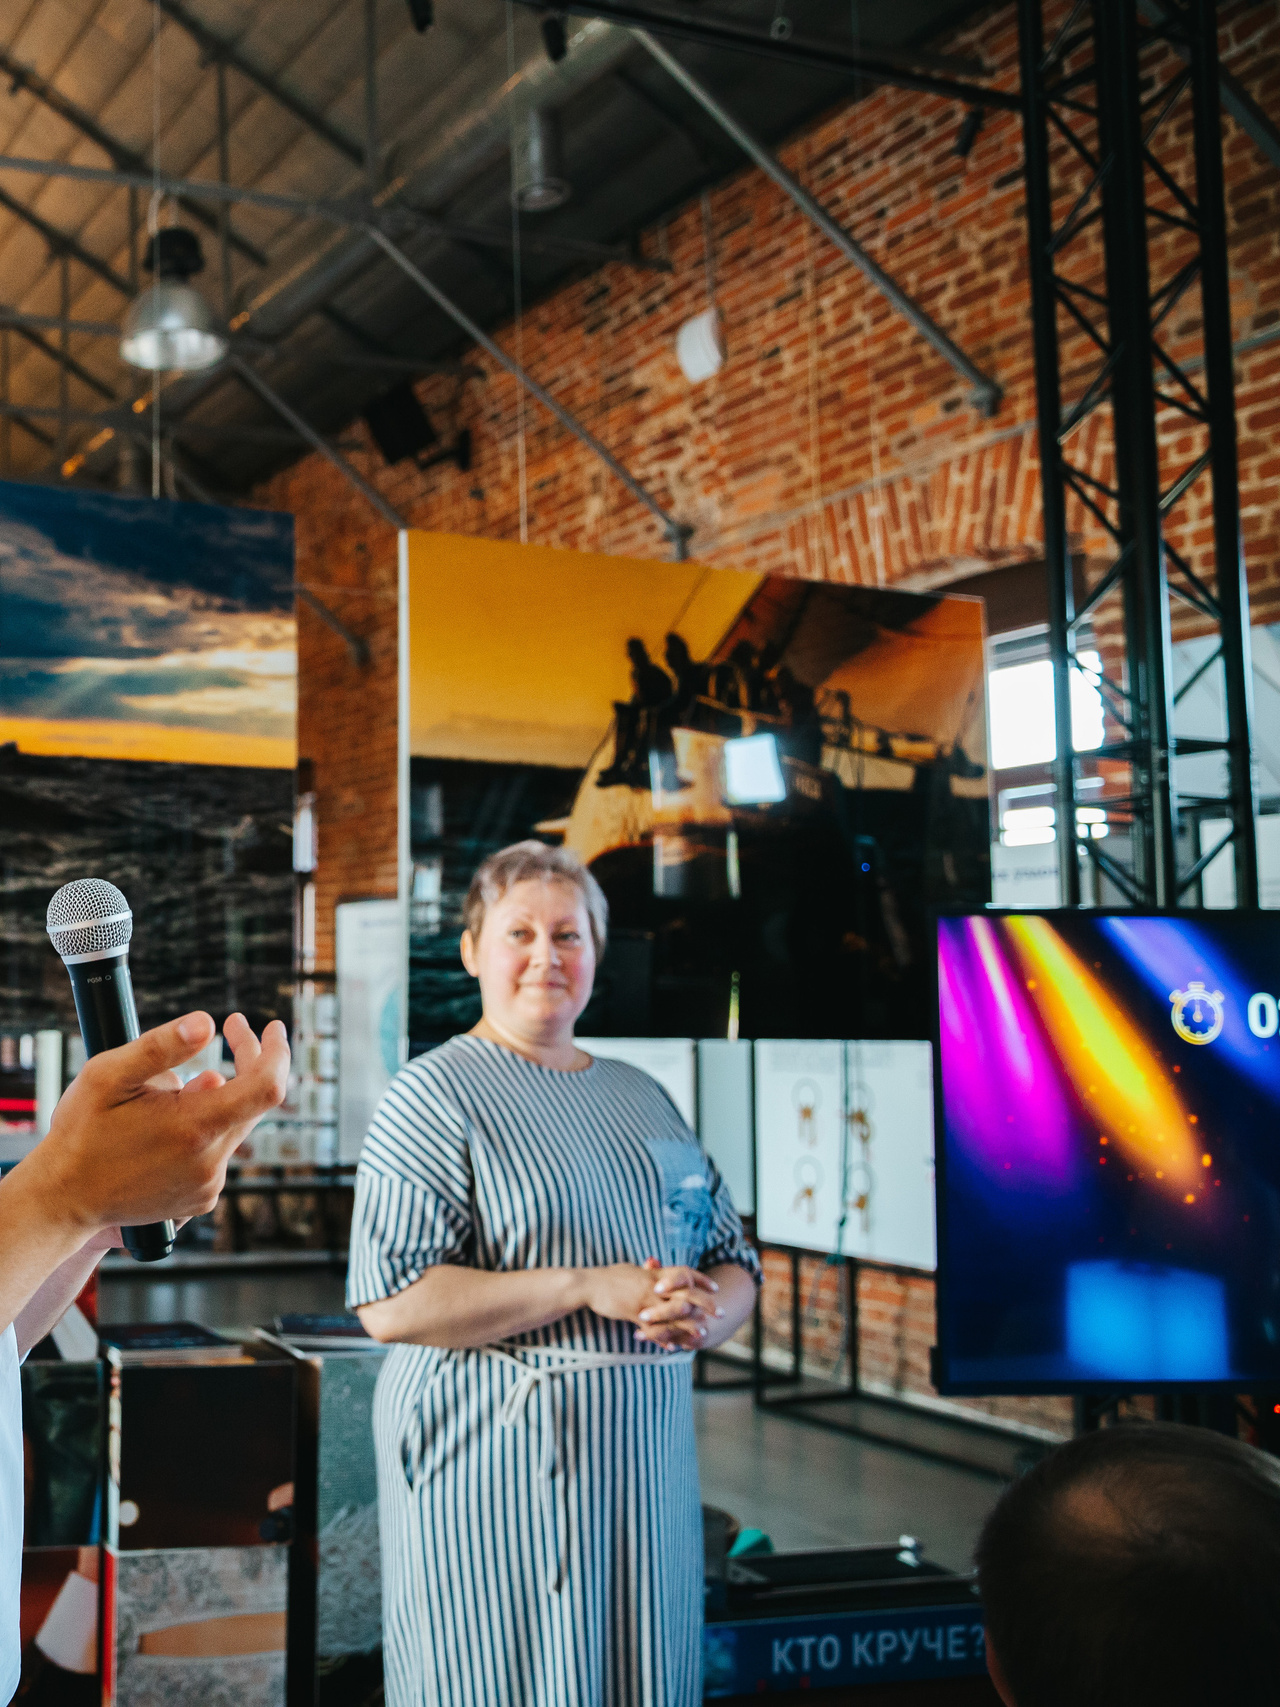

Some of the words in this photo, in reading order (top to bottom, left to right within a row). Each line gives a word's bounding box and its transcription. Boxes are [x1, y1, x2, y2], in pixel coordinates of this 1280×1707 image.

[1248, 992, 1280, 1038] 0
[772, 1635, 841, 1674] КТО
[852, 1624, 986, 1667] КРУЧЕ?
